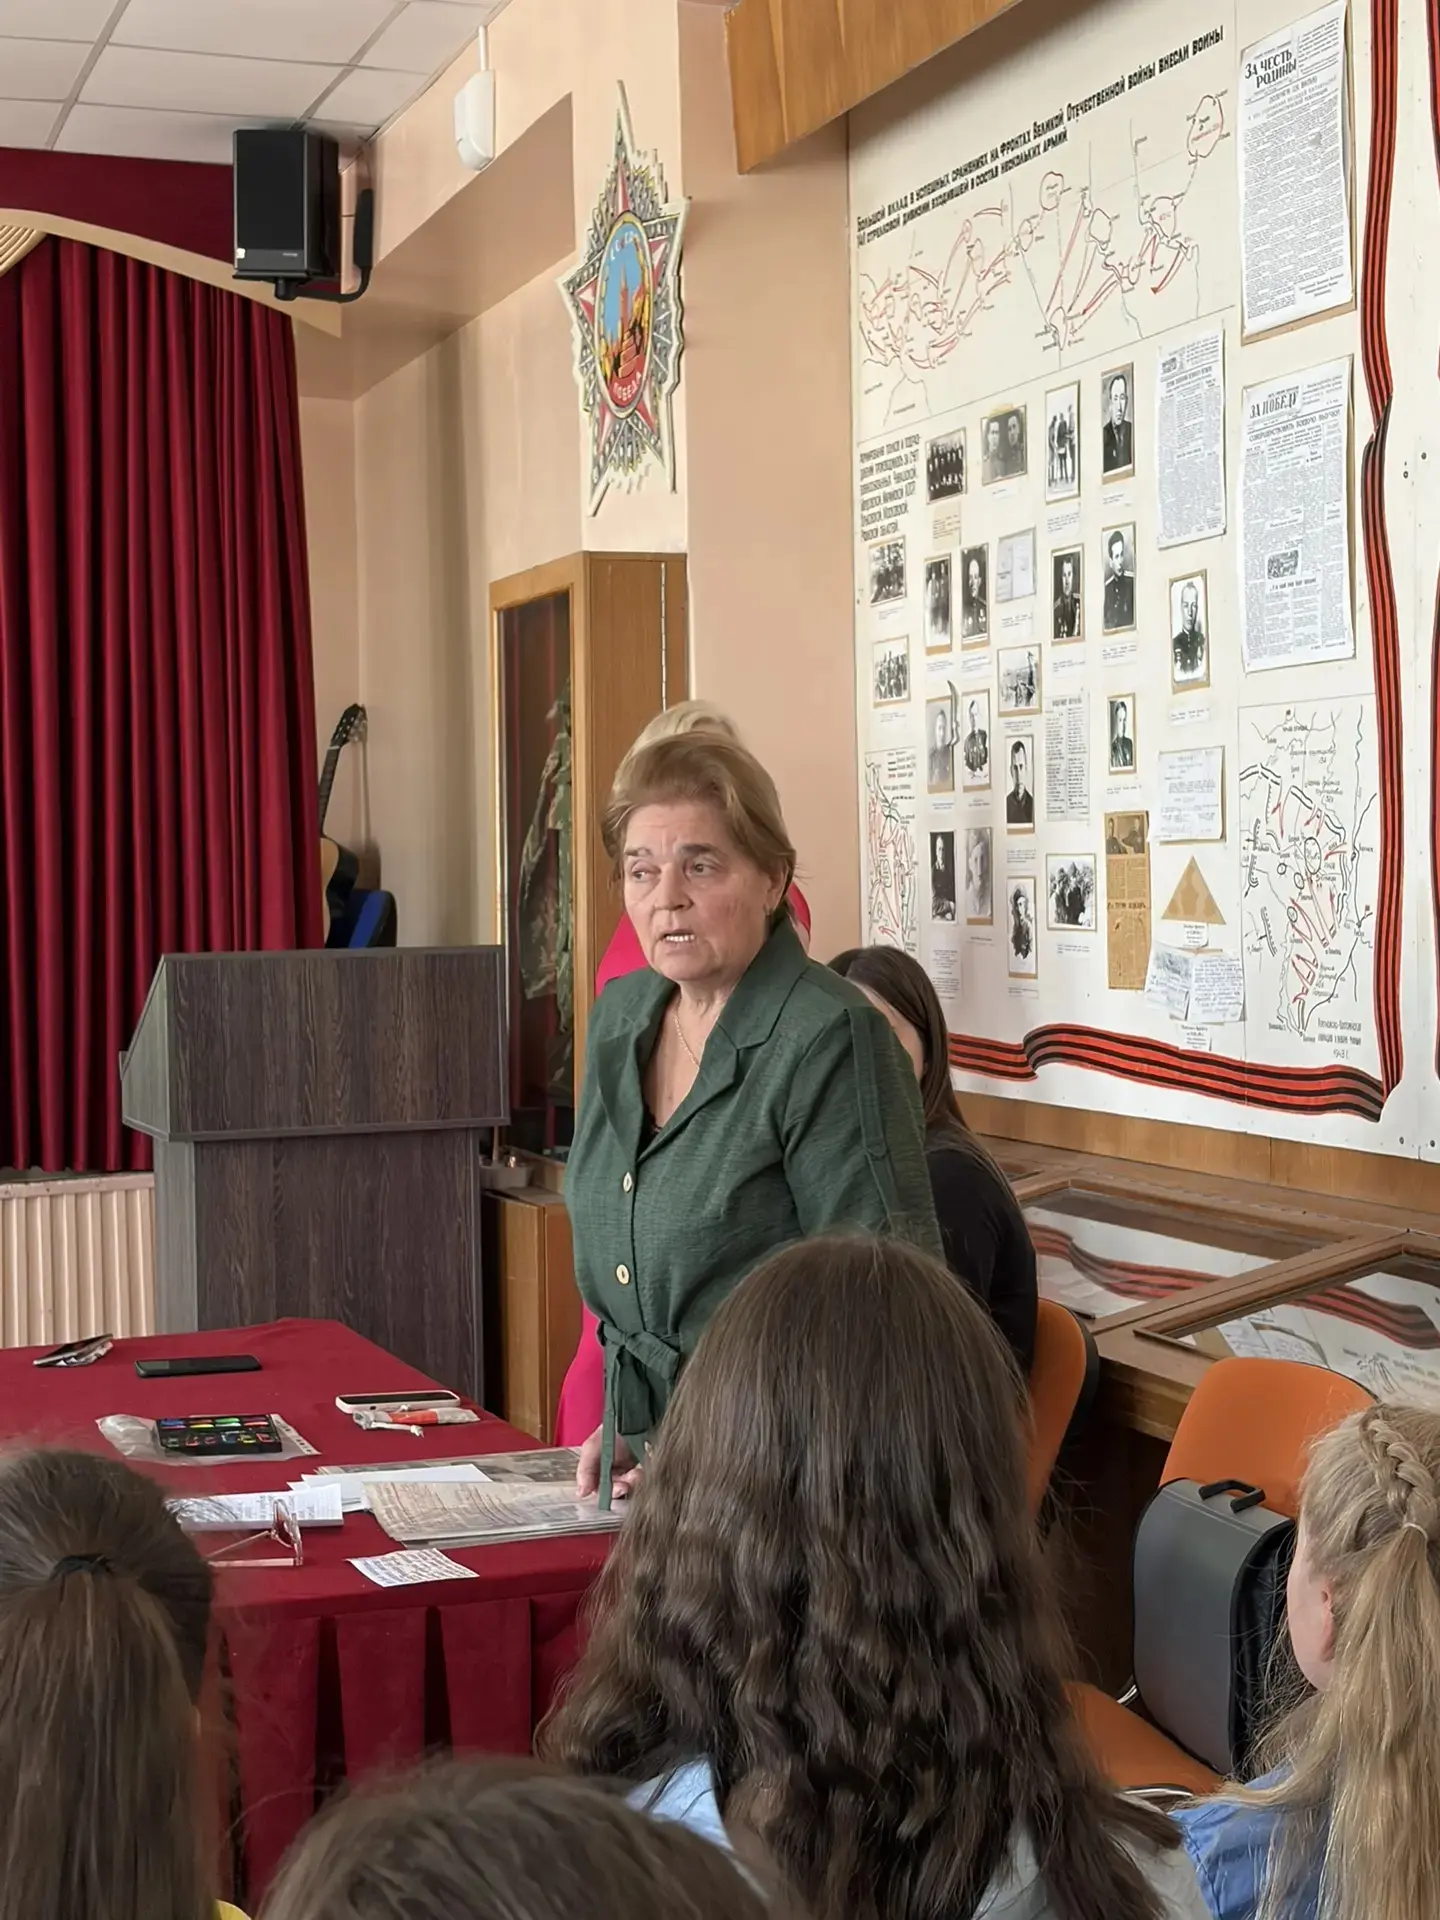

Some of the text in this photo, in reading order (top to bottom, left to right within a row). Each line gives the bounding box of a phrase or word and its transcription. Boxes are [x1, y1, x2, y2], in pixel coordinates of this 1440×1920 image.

[1244, 63, 1258, 79] ЗА
[1260, 48, 1292, 72] ЧЕСТЬ
[1256, 58, 1297, 88] РОДИНЫ
[952, 153, 989, 182] СРАЖЕНИЯХ
[990, 147, 999, 165] НА
[1000, 132, 1031, 157] ФРОНТАХ
[1033, 109, 1064, 140] ВЕЛИКОЙ
[1067, 75, 1125, 122] ОТЕЧЕСТВЕННОЙ
[1128, 62, 1156, 89] ВОЙНЫ
[1159, 45, 1189, 74] ВНЕСЛИ
[1192, 25, 1224, 56] ВОИНЫ
[976, 165, 999, 187] СОСТАВ
[1000, 144, 1041, 174] НЕСКОЛЬКИХ
[1043, 126, 1068, 153] АРМИЙ
[612, 371, 642, 402] ПОБЕДА
[1249, 403, 1260, 419] ЗА
[1262, 390, 1299, 416] ПОБЕДУ
